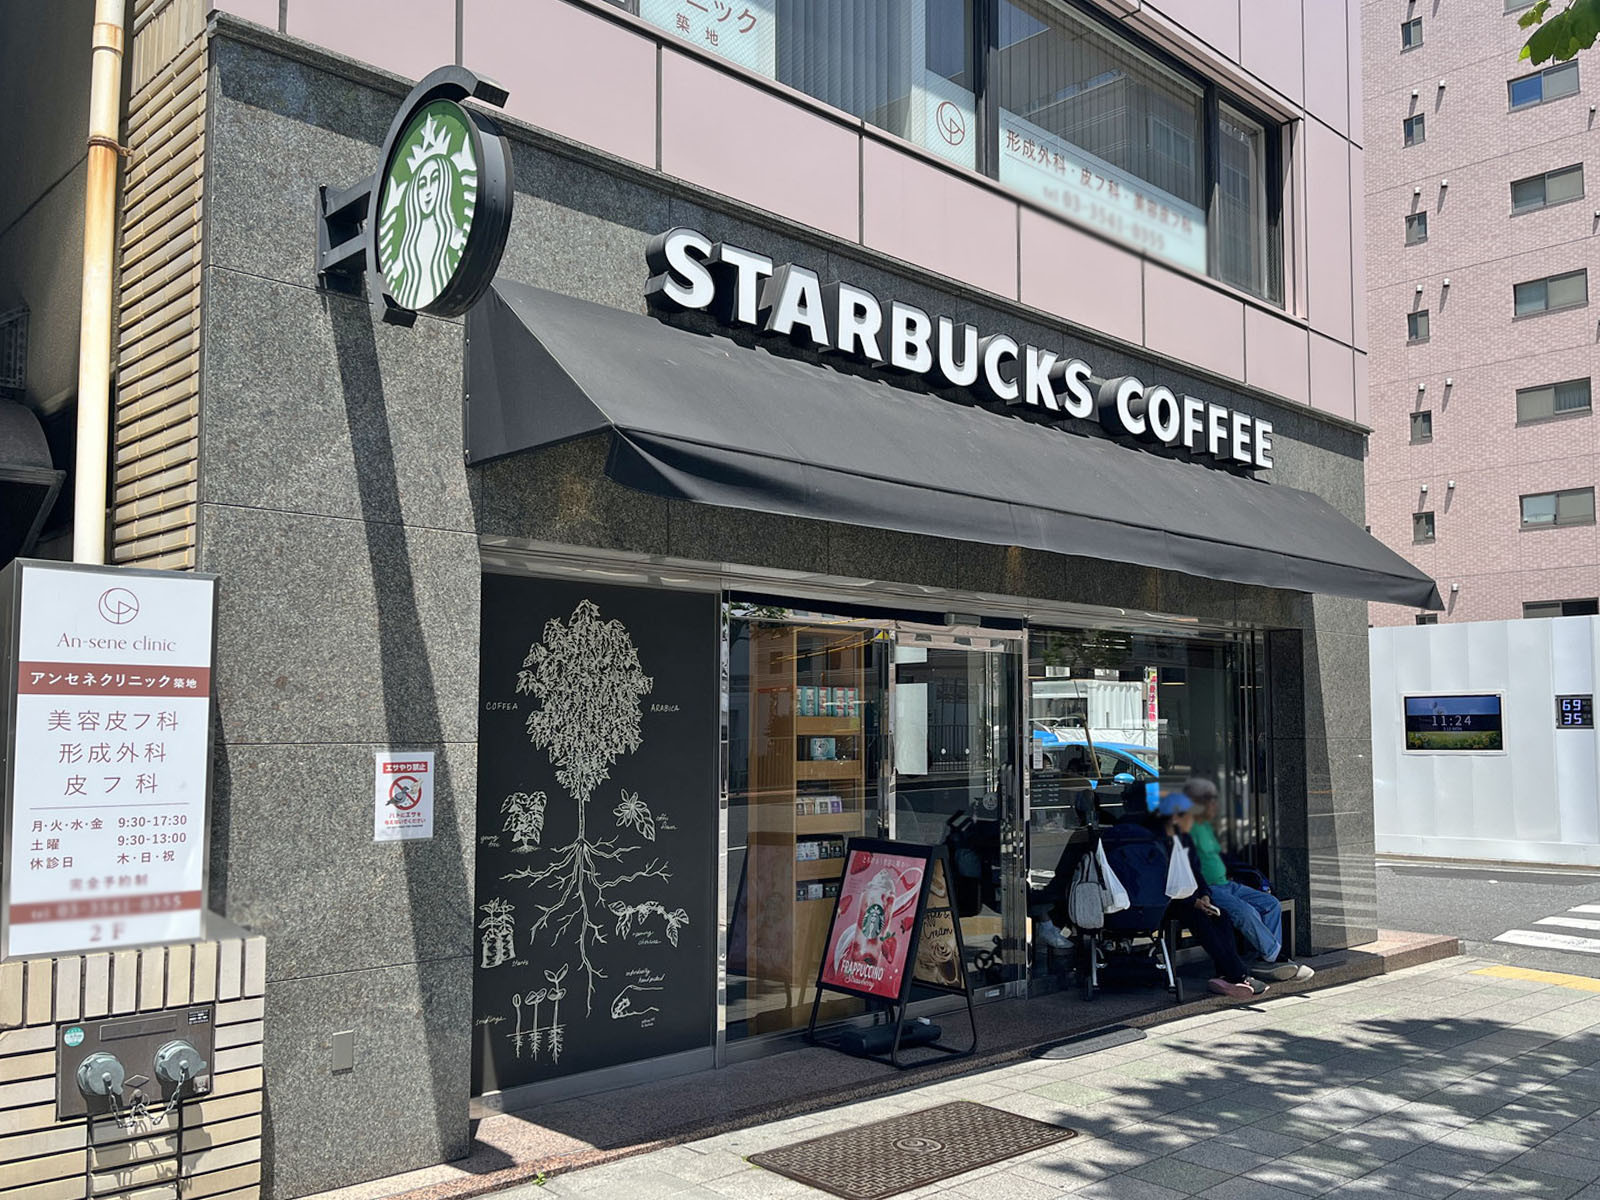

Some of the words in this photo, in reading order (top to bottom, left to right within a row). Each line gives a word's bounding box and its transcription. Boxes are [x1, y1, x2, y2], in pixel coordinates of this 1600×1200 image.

[676, 13, 719, 46] 築地
[662, 227, 1095, 420] STARBUCKS
[1115, 375, 1274, 470] COFFEE
[56, 632, 127, 650] An-sene
[132, 635, 176, 652] clinic
[486, 702, 518, 711] COFFEA
[650, 703, 680, 712] ARABICA
[1562, 699, 1581, 711] 69
[48, 710, 179, 732] 美容皮フ科
[1431, 715, 1472, 726] 11:24
[1563, 713, 1582, 725] 35
[59, 742, 166, 765] 形成外科
[64, 772, 158, 796] 皮フ科
[118, 815, 187, 828] 9:30-17:30
[30, 838, 60, 851] 土曜
[117, 832, 187, 846] 9:30-13:00
[30, 857, 73, 870] 休診日
